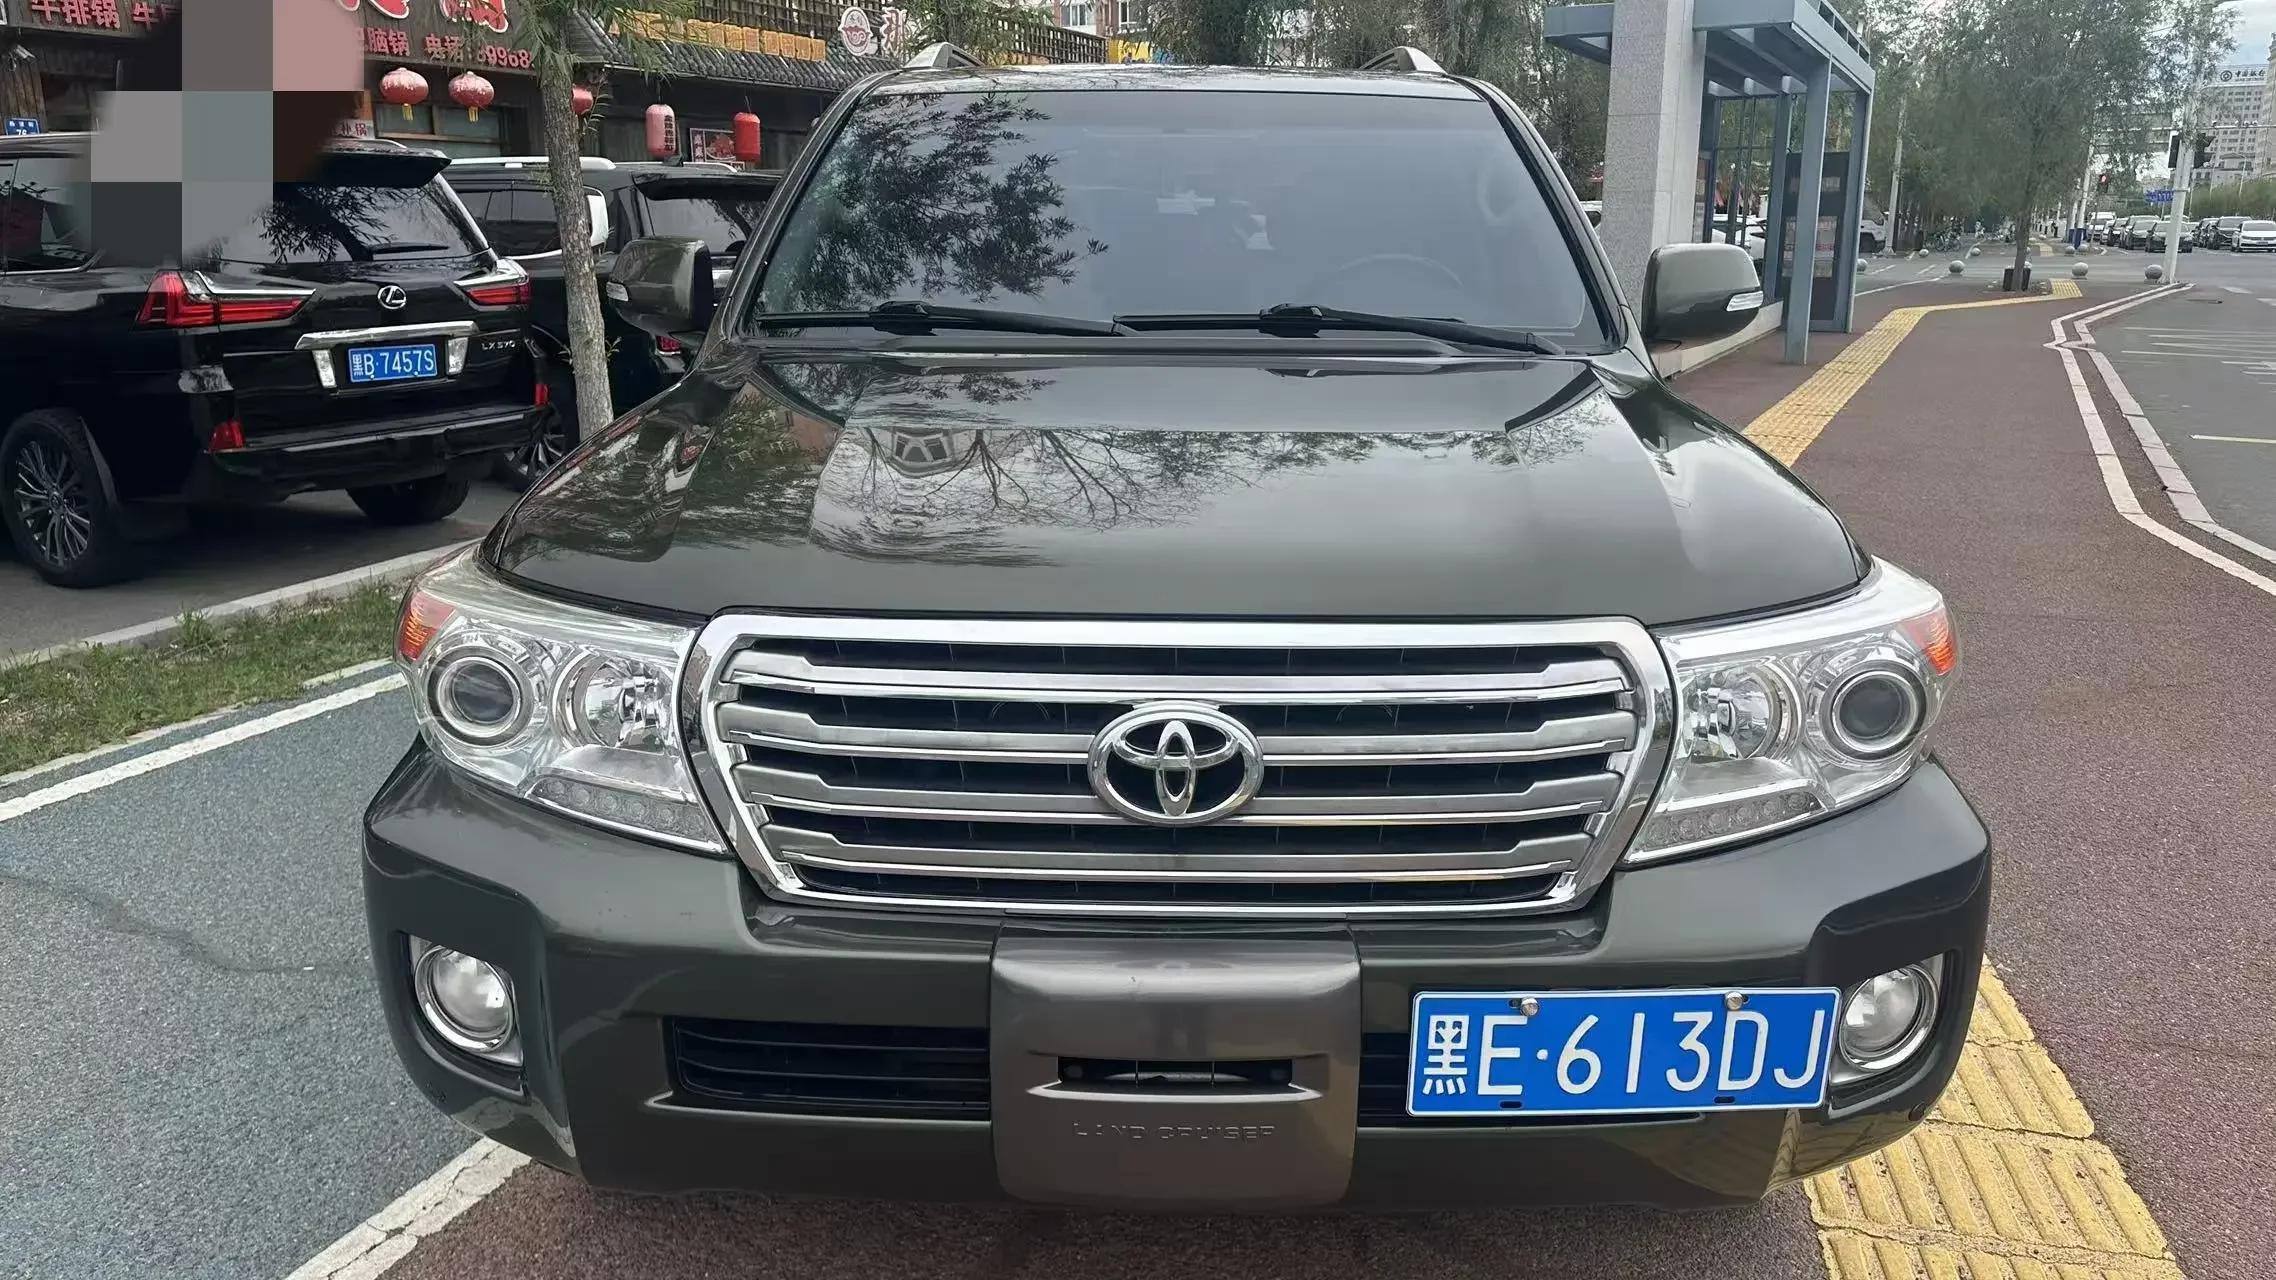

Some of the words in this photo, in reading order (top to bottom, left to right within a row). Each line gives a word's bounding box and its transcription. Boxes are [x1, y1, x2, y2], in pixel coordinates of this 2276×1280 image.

[1422, 1010, 1826, 1096] 黑E·613DJ
[1072, 1122, 1145, 1139] LAND
[1157, 1125, 1276, 1140] CRUISER
